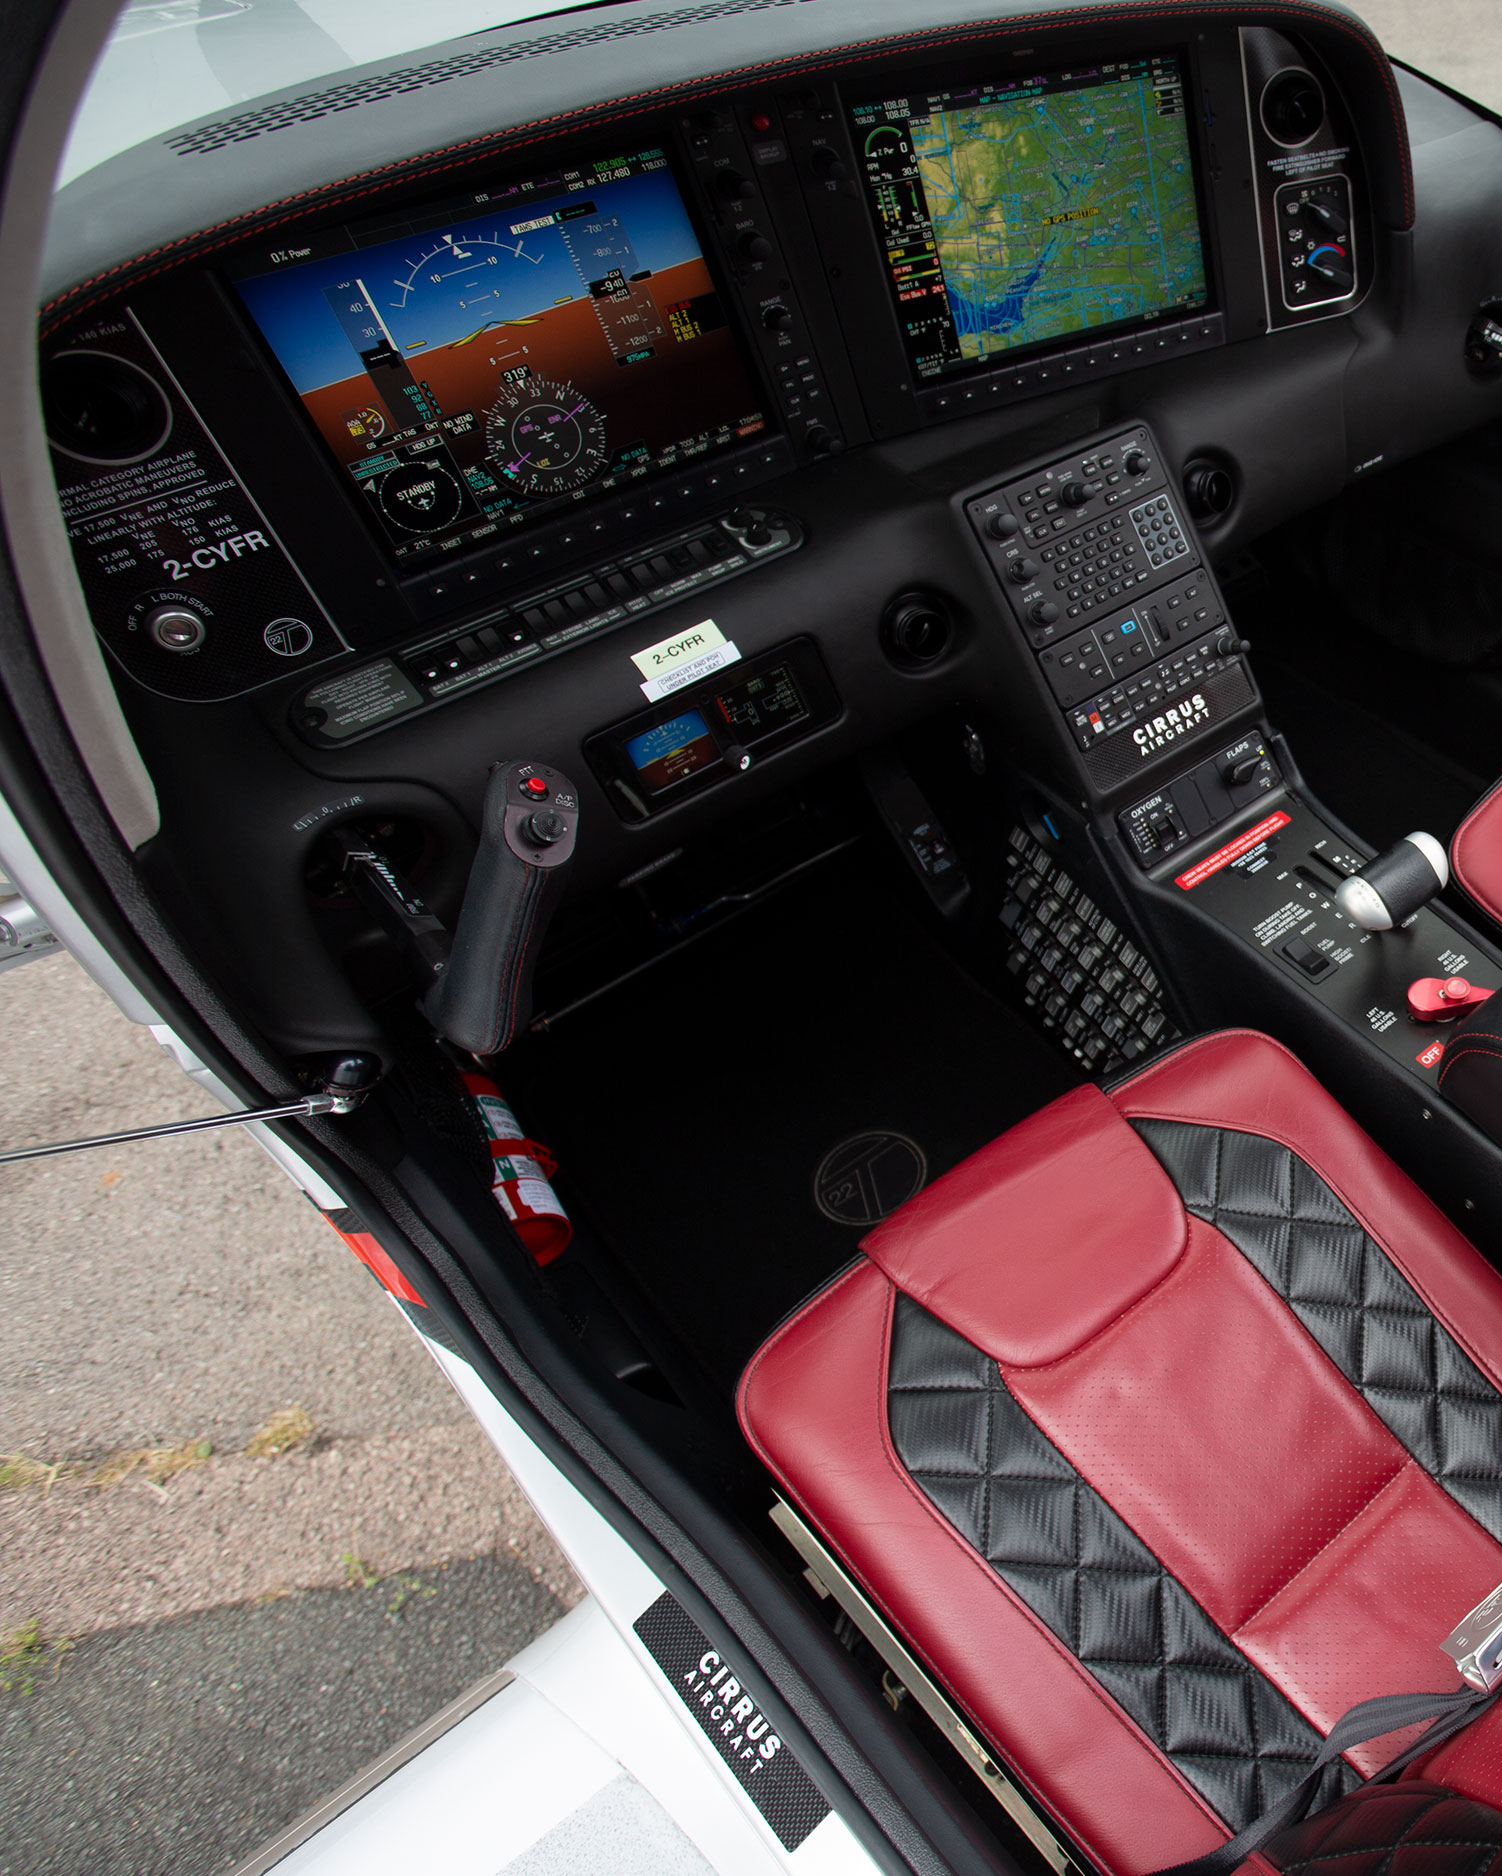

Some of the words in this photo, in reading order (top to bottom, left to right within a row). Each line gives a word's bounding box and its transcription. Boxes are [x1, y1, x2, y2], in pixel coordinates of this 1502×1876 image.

[597, 167, 630, 183] 127.480
[58, 483, 89, 499] RMAL
[90, 465, 146, 487] CATEGORY
[147, 450, 197, 470] AIRPLANE
[75, 480, 133, 503] ACROBATIC
[137, 461, 197, 485] MANEUVERS
[153, 469, 206, 490] APPROVED
[146, 501, 168, 514] AND
[195, 479, 236, 498] REDUCE
[87, 524, 137, 545] LINEARLY
[137, 515, 165, 531] WITH
[208, 514, 233, 527] KIAS
[214, 524, 239, 538] KIAS
[163, 530, 270, 581] 2-CYFR
[159, 592, 187, 601] BOTH
[187, 597, 214, 617] START
[661, 667, 692, 685] CHECKLIST
[693, 659, 706, 668] AND
[666, 677, 687, 690] UNDER
[687, 669, 705, 679] PILOT
[705, 661, 720, 671] SEAT
[1133, 694, 1205, 745] CIRRUS
[1140, 708, 1210, 756] AIRCRAFT
[1226, 741, 1249, 760] FLAPS
[519, 766, 534, 776] PTT
[1131, 795, 1162, 818] OXYGEN
[1300, 922, 1317, 935] BOOST
[1401, 915, 1418, 928] CUTOFF
[1317, 939, 1330, 948] FUEL
[1322, 940, 1335, 951] PUMP
[1366, 1007, 1379, 1018] LEFT
[1421, 1047, 1440, 1064] OFF
[699, 1651, 781, 1759] CIRRUS
[683, 1670, 763, 1774] AIRCRAFT
